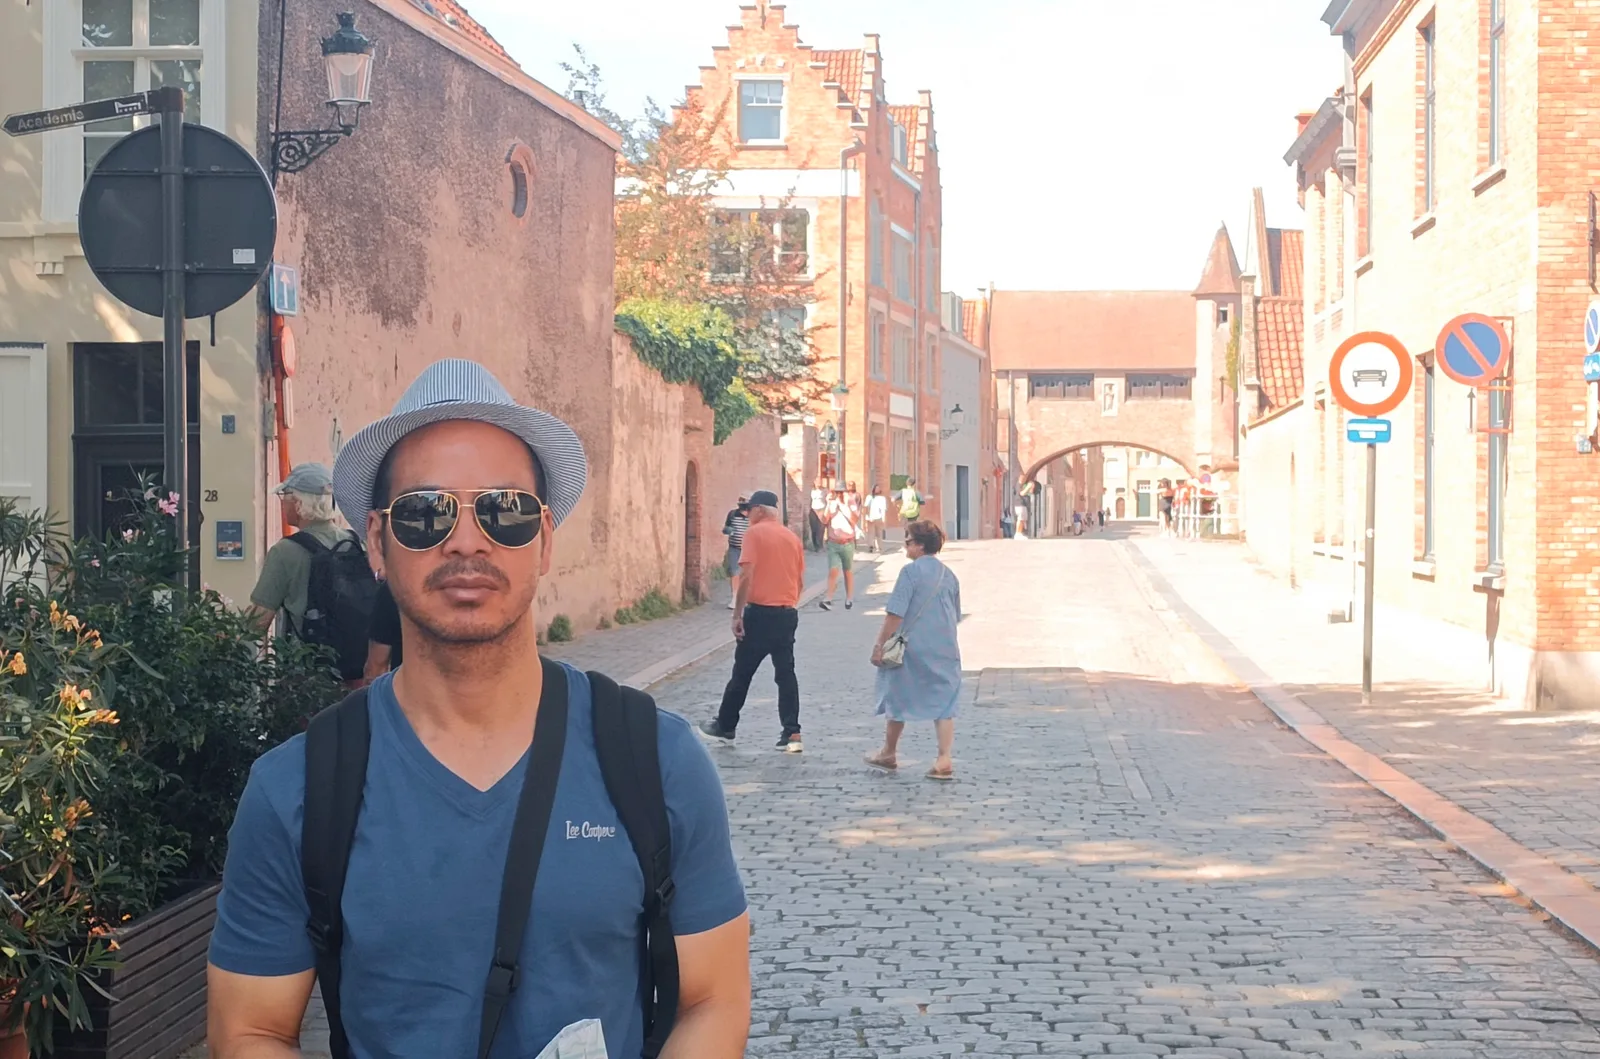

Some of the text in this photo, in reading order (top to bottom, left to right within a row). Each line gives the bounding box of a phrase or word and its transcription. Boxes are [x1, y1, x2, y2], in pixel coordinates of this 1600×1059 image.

[204, 489, 218, 502] 28
[565, 820, 615, 842] Lee Cooper
